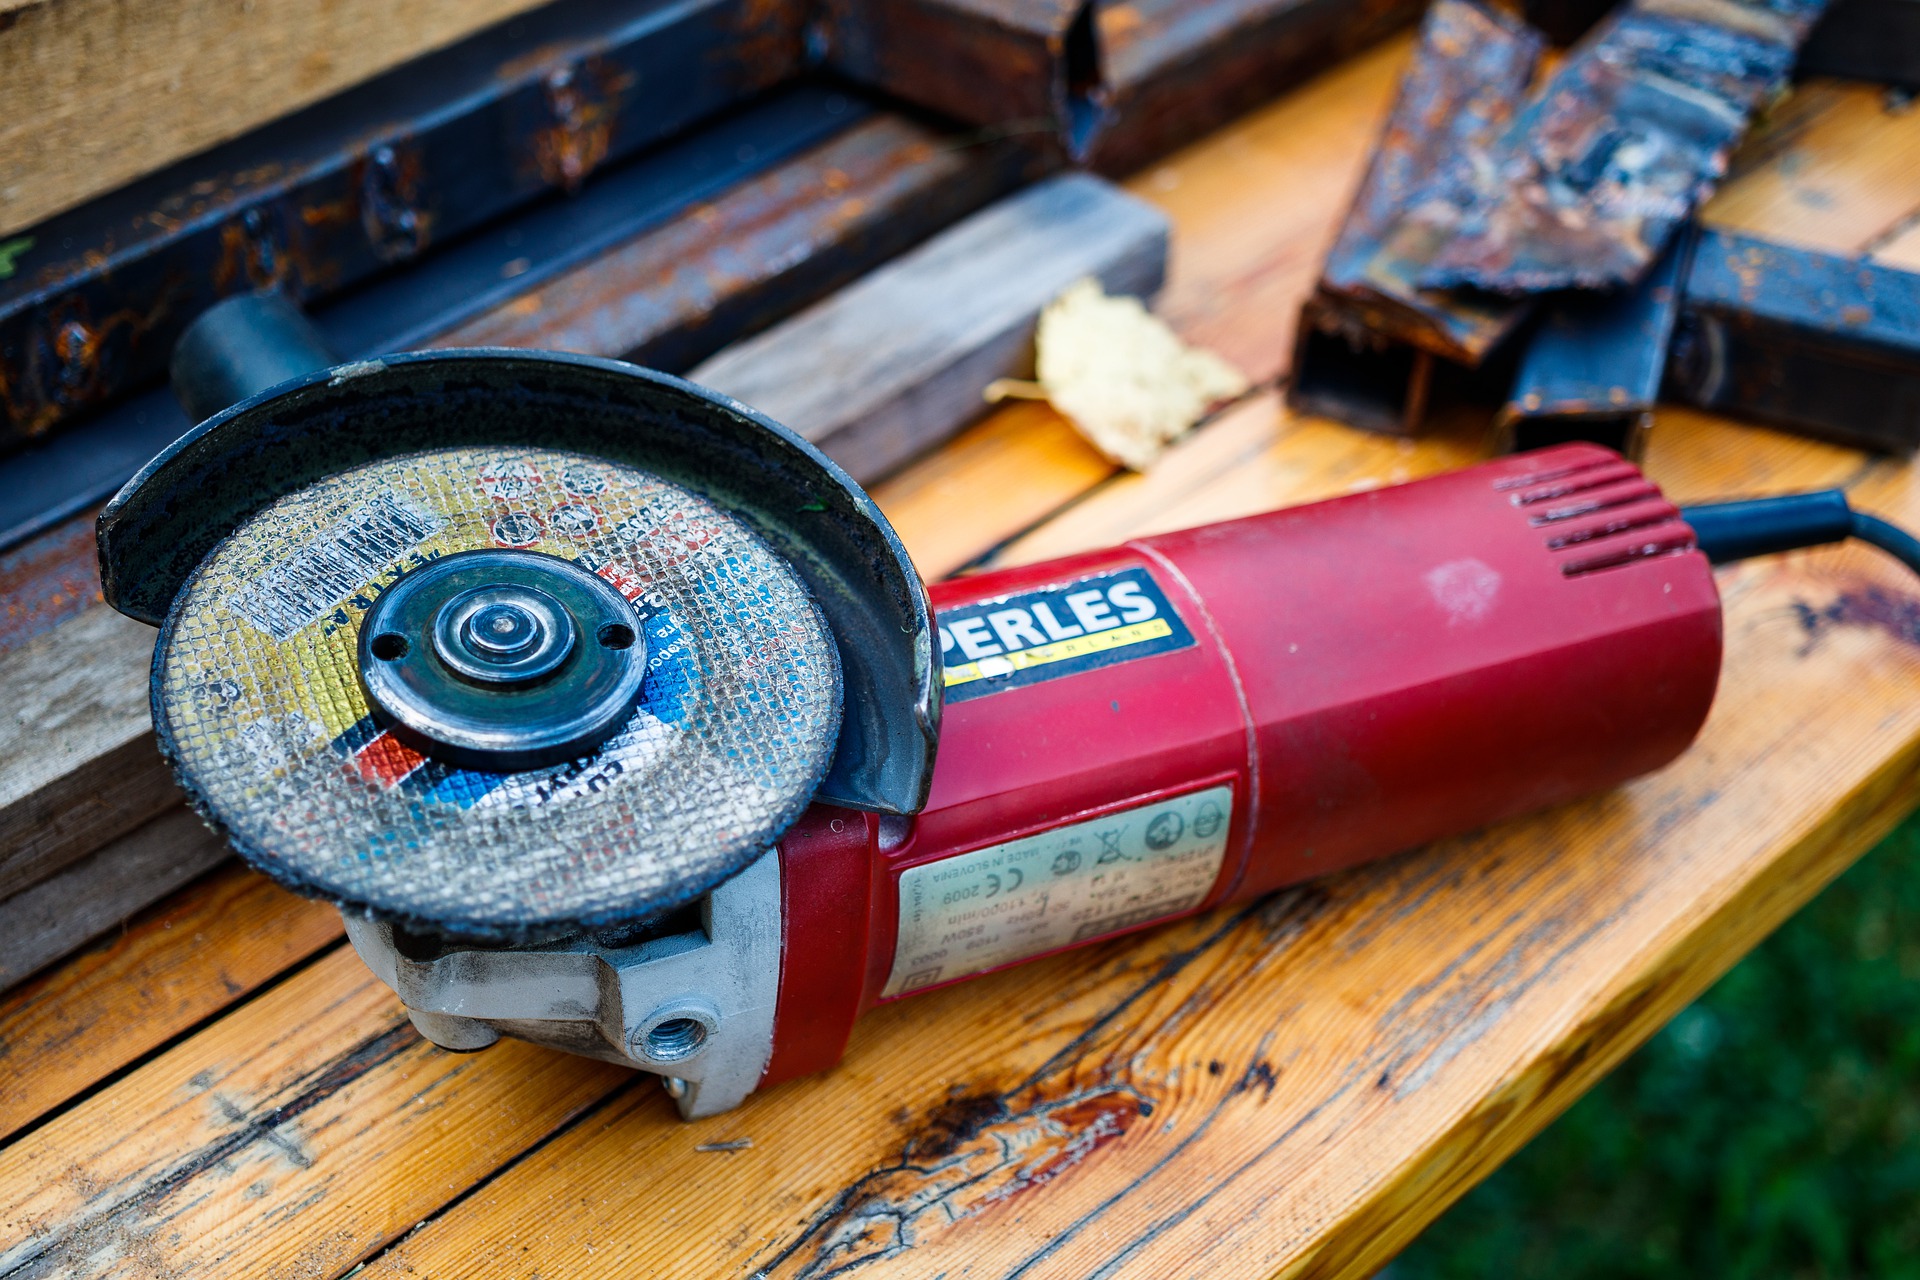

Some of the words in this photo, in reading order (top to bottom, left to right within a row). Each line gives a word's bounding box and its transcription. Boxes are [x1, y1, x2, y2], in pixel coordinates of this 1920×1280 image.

[991, 856, 1002, 867] IN
[1007, 847, 1038, 863] MADE
[932, 861, 988, 881] SLOVENIA
[943, 884, 978, 905] 2009
